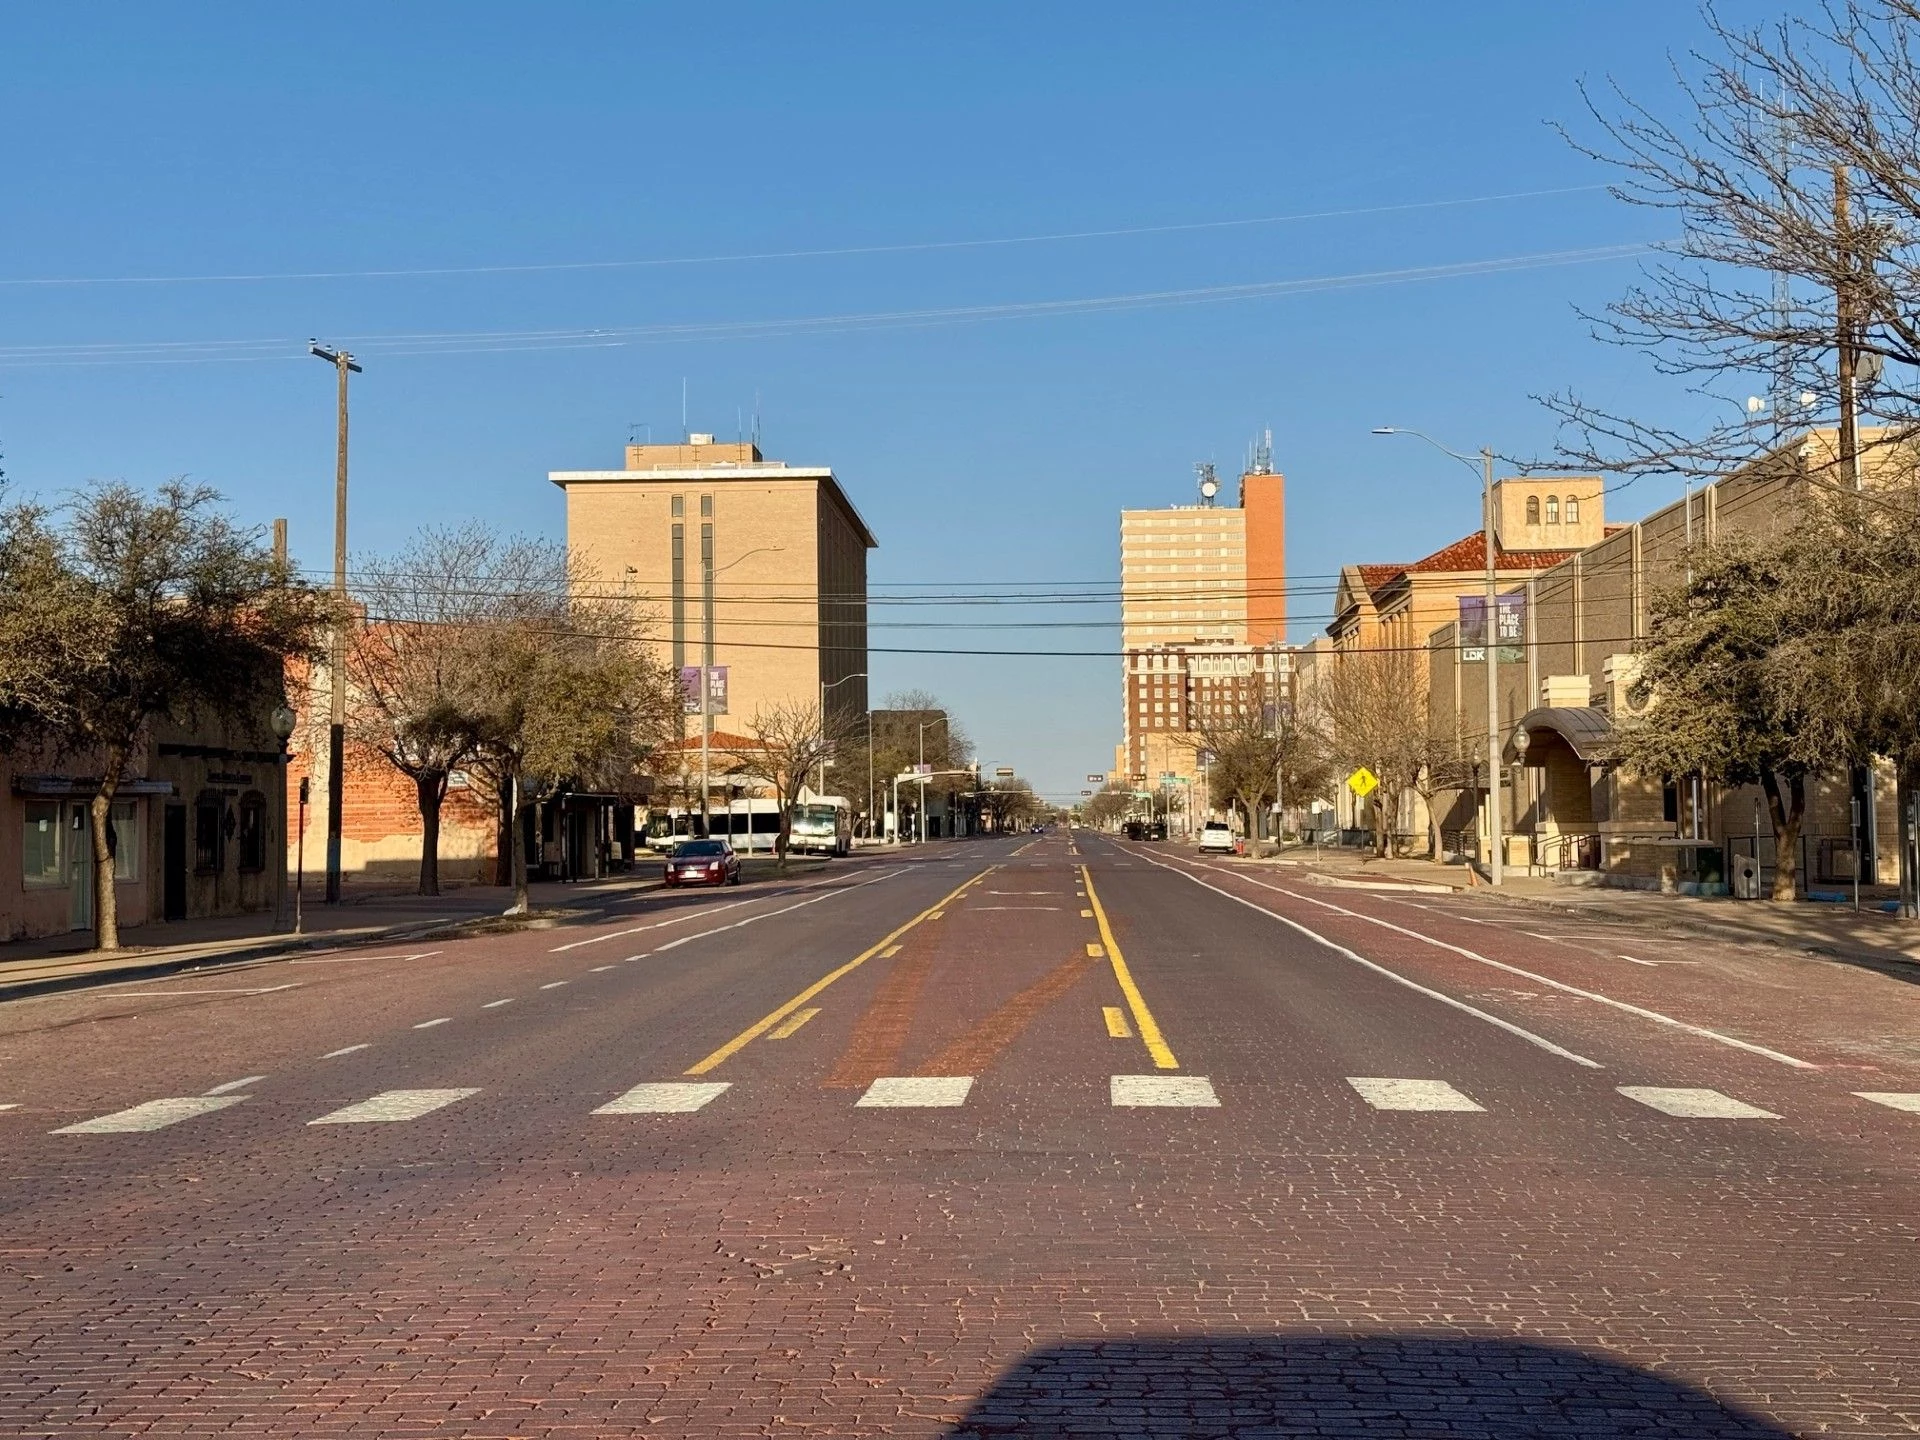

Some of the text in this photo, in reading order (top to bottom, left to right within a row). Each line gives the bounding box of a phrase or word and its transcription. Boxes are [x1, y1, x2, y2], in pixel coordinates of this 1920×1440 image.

[1499, 602, 1511, 614] THE
[1499, 614, 1520, 625] PLACE
[1499, 625, 1518, 637] TO BE
[1463, 651, 1485, 661] LDK
